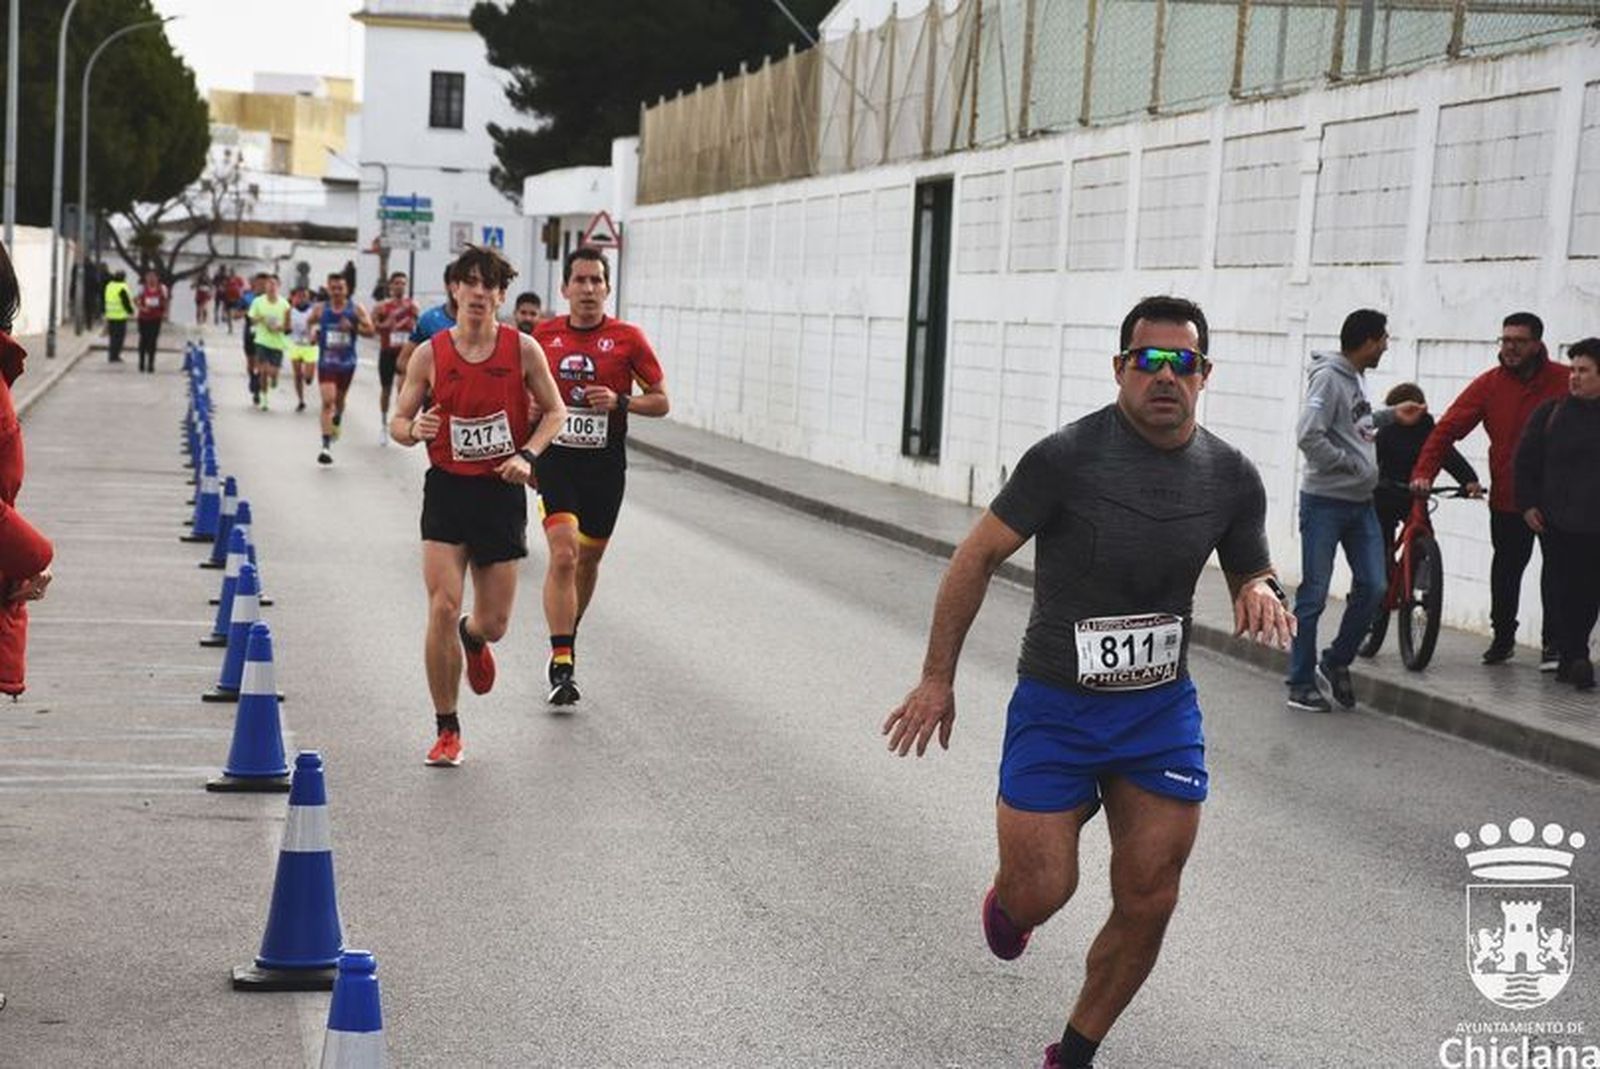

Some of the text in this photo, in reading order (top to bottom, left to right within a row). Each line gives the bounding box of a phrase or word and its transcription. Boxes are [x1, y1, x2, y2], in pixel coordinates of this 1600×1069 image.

[461, 425, 494, 447] 217
[566, 416, 594, 435] 106
[1100, 631, 1155, 669] 811
[1082, 662, 1177, 687] CHICLANA
